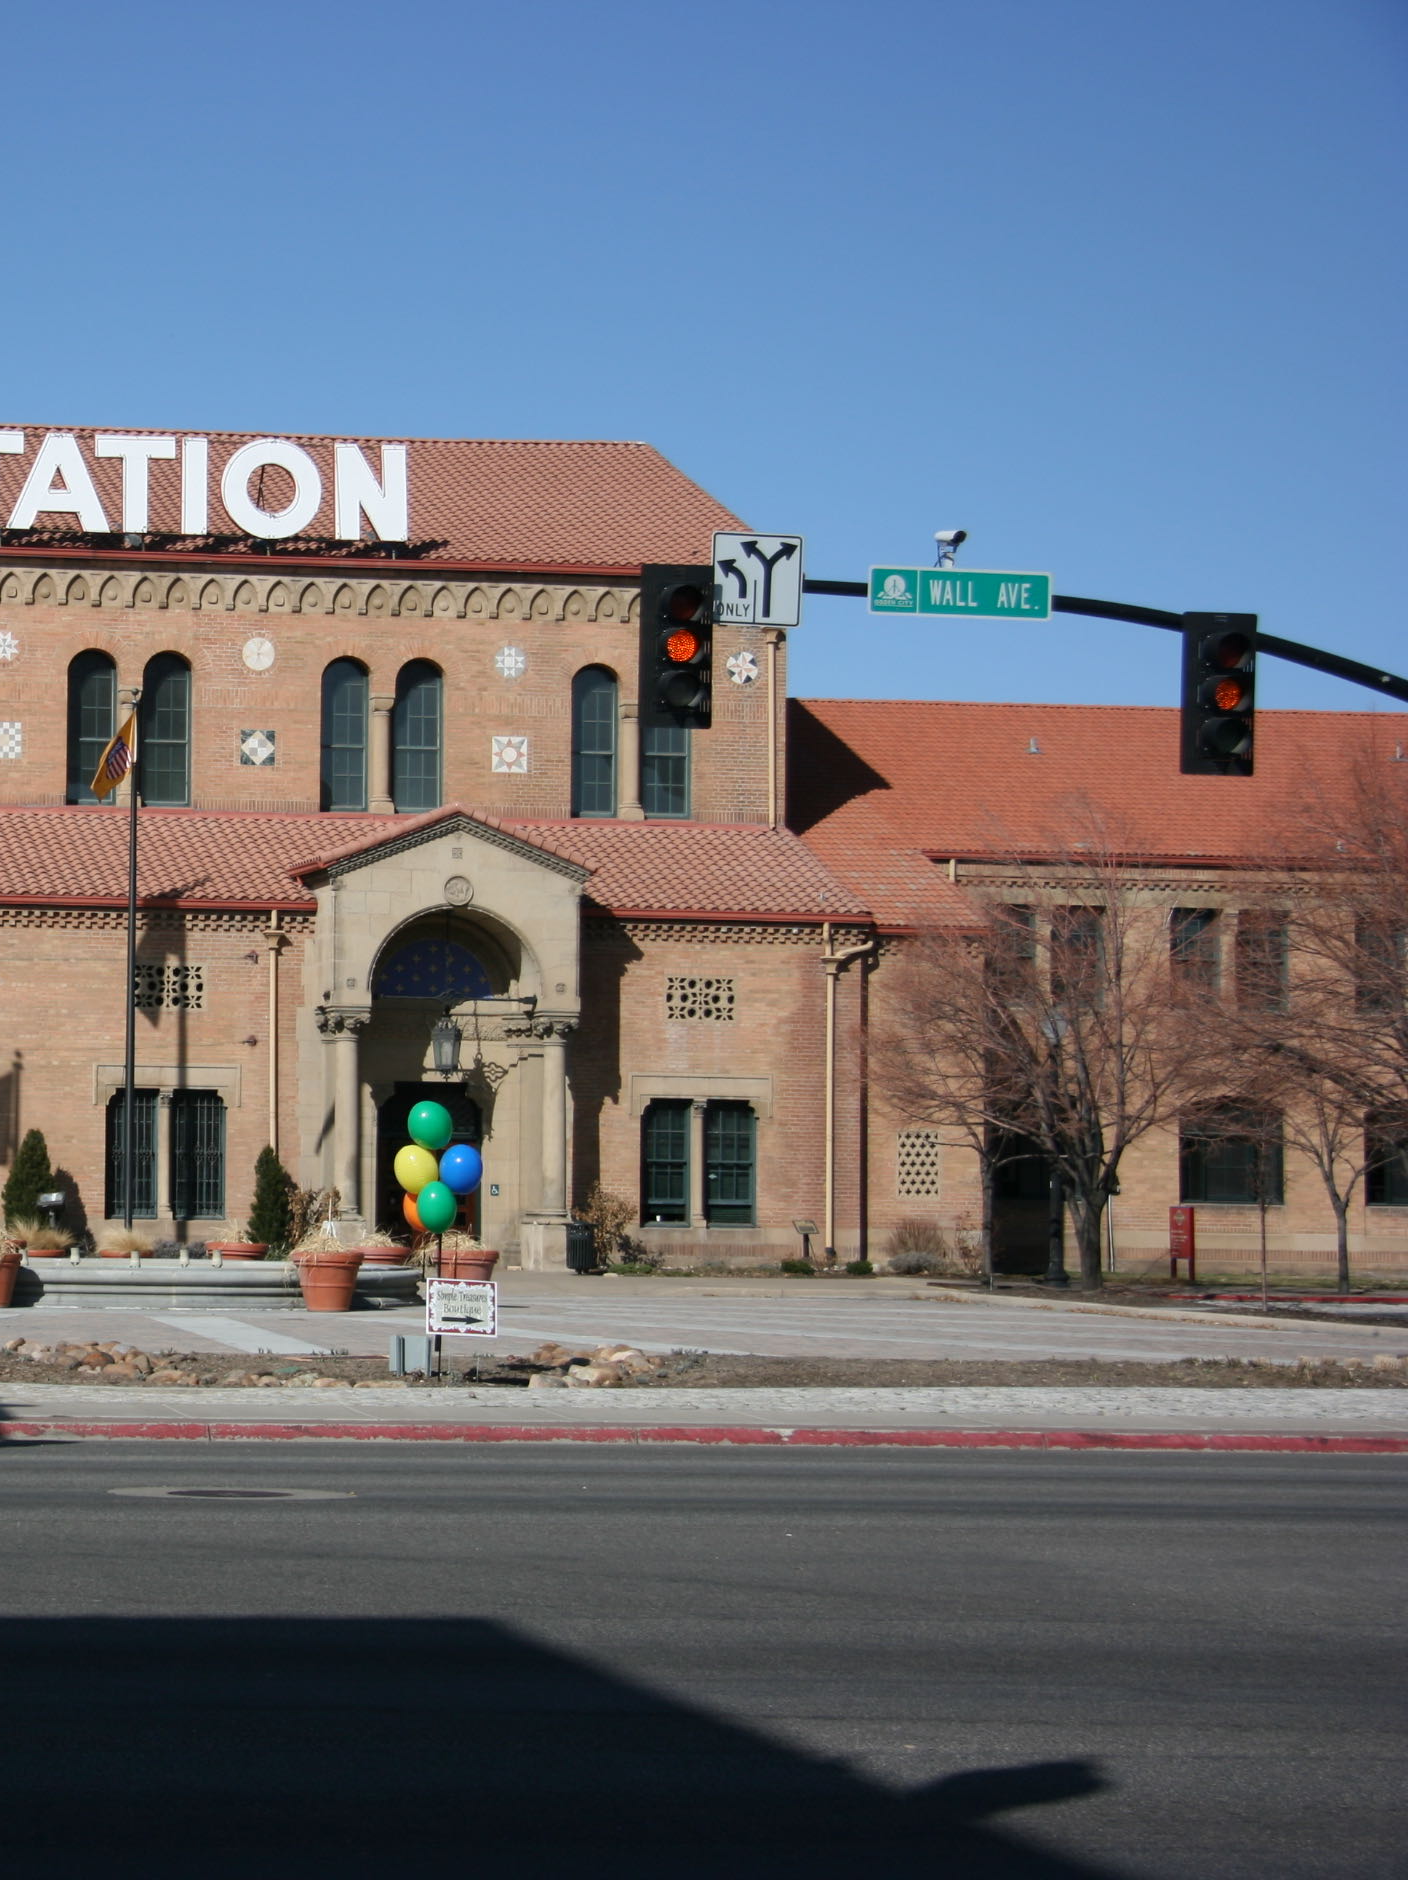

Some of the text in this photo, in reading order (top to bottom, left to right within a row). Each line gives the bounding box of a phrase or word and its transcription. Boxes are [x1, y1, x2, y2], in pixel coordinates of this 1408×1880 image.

[929, 579, 1040, 610] WALL AVE.
[716, 602, 750, 617] ONLY
[459, 1291, 488, 1303] Treasures
[443, 1304, 482, 1316] Boutique
